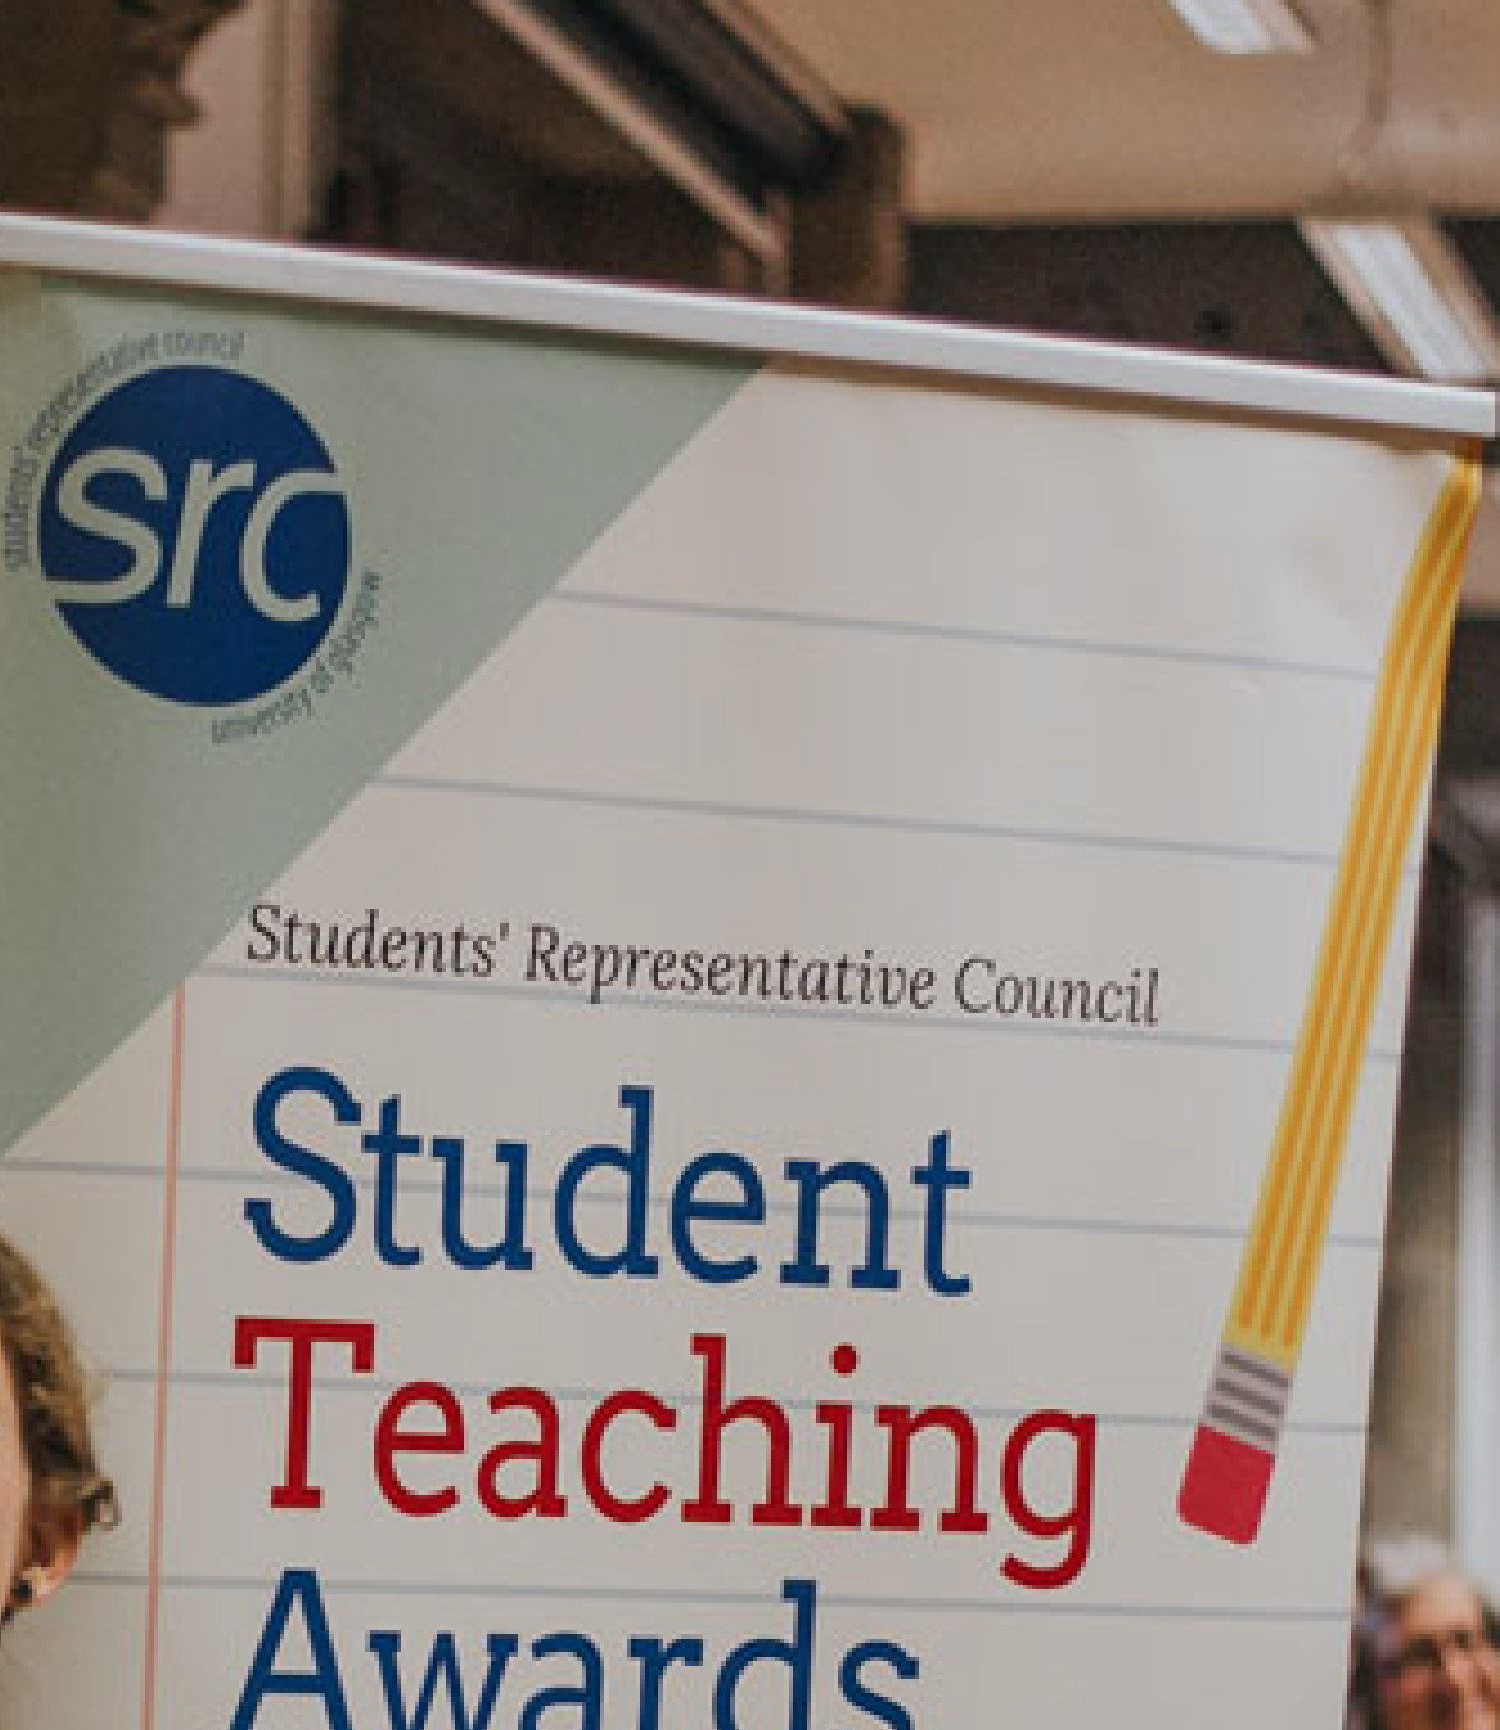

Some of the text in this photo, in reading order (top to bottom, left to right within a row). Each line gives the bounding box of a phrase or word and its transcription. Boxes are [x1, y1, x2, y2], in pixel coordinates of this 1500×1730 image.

[164, 332, 245, 361] council
[212, 690, 312, 744] university
[246, 904, 1160, 1027] Students' Representative Council
[244, 1065, 972, 1297] Student
[233, 1315, 1097, 1589] Teaching
